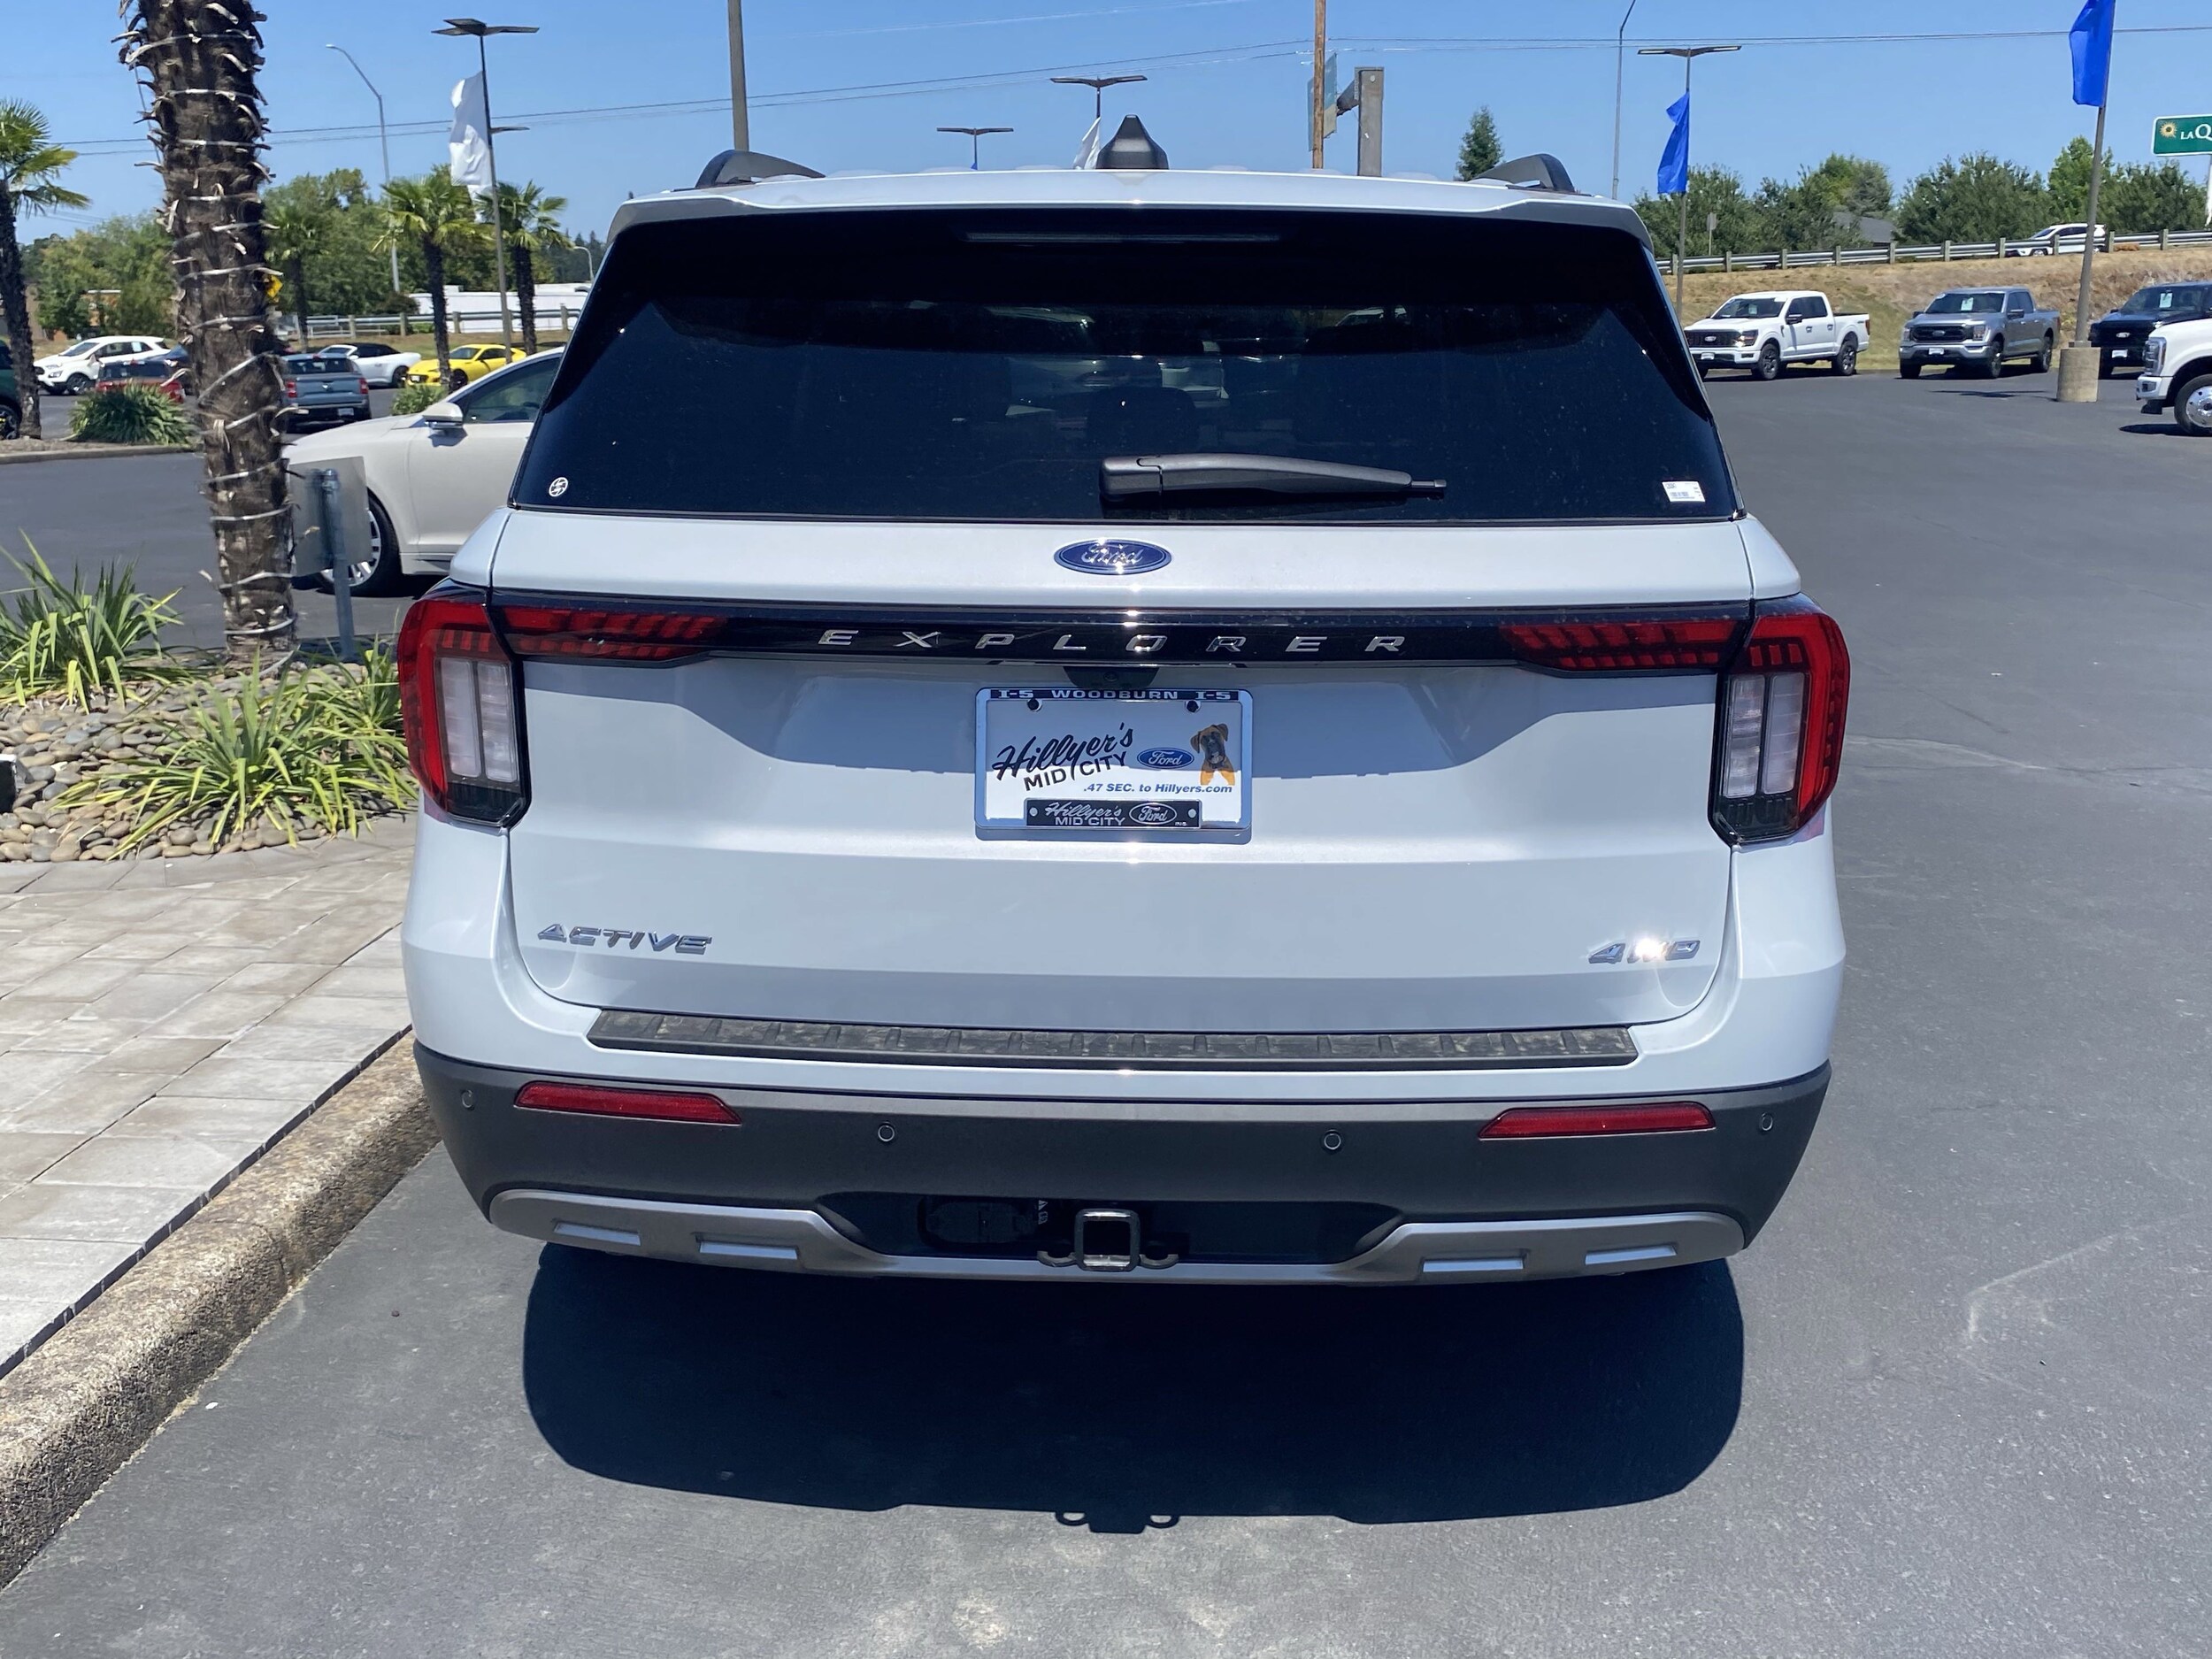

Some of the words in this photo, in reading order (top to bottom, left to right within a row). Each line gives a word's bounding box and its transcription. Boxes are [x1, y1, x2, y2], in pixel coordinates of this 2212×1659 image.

[2180, 131, 2194, 140] LA
[1081, 541, 1144, 565] Ford
[818, 629, 1405, 653] EXPLORER
[998, 689, 1034, 698] I-5
[1051, 689, 1178, 699] WOODBURN
[1195, 691, 1231, 700] I-5
[991, 722, 1133, 780] Hillyer's
[1148, 749, 1184, 766] Ford
[1023, 768, 1067, 791] MID
[1079, 751, 1127, 776] CITY
[1105, 783, 1134, 792] SEC.
[1139, 784, 1151, 793] to
[1155, 784, 1233, 795] Hillyers.com
[1044, 801, 1122, 820] Hillyer's
[1138, 805, 1168, 822] Ford
[1055, 817, 1083, 826] MID
[1087, 817, 1125, 826] CITY
[537, 923, 712, 955] ACTIVE
